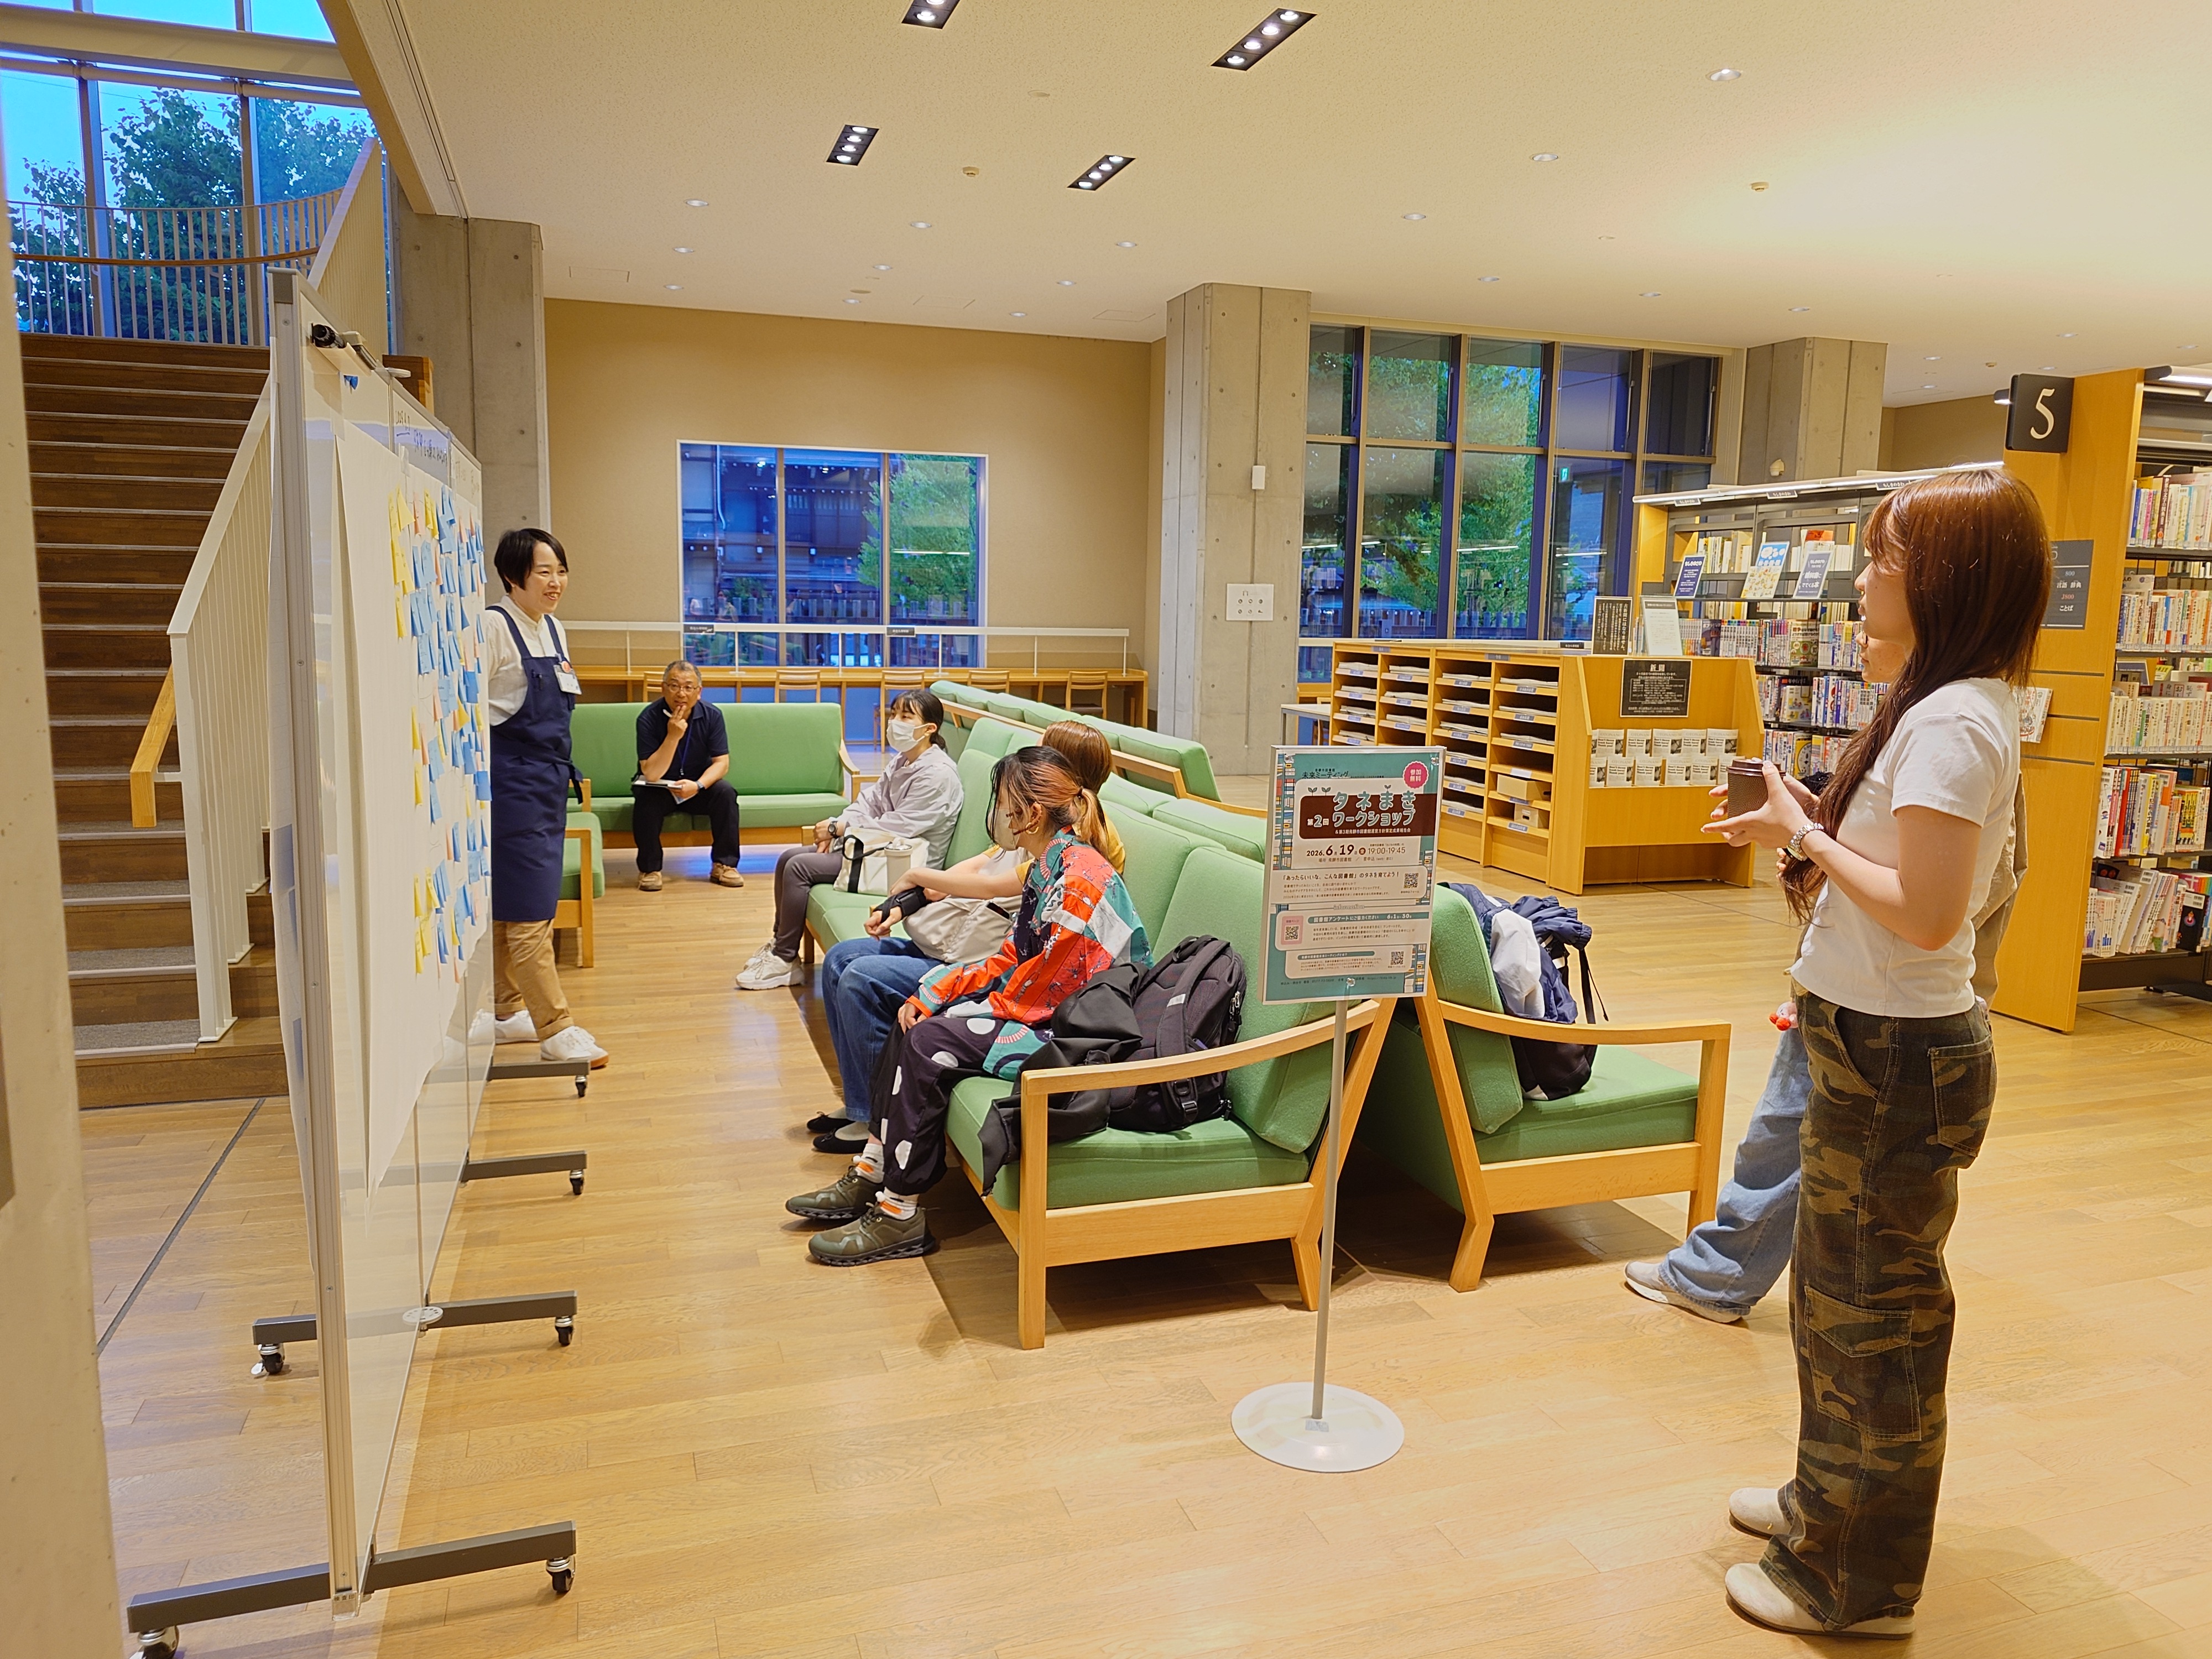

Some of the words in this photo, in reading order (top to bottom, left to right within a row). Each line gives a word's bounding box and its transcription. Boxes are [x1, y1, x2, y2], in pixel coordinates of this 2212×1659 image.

[2030, 388, 2056, 439] 5
[1333, 790, 1416, 811] タネまき
[1307, 815, 1329, 827] 第2回
[1332, 808, 1416, 827] ワークショップ
